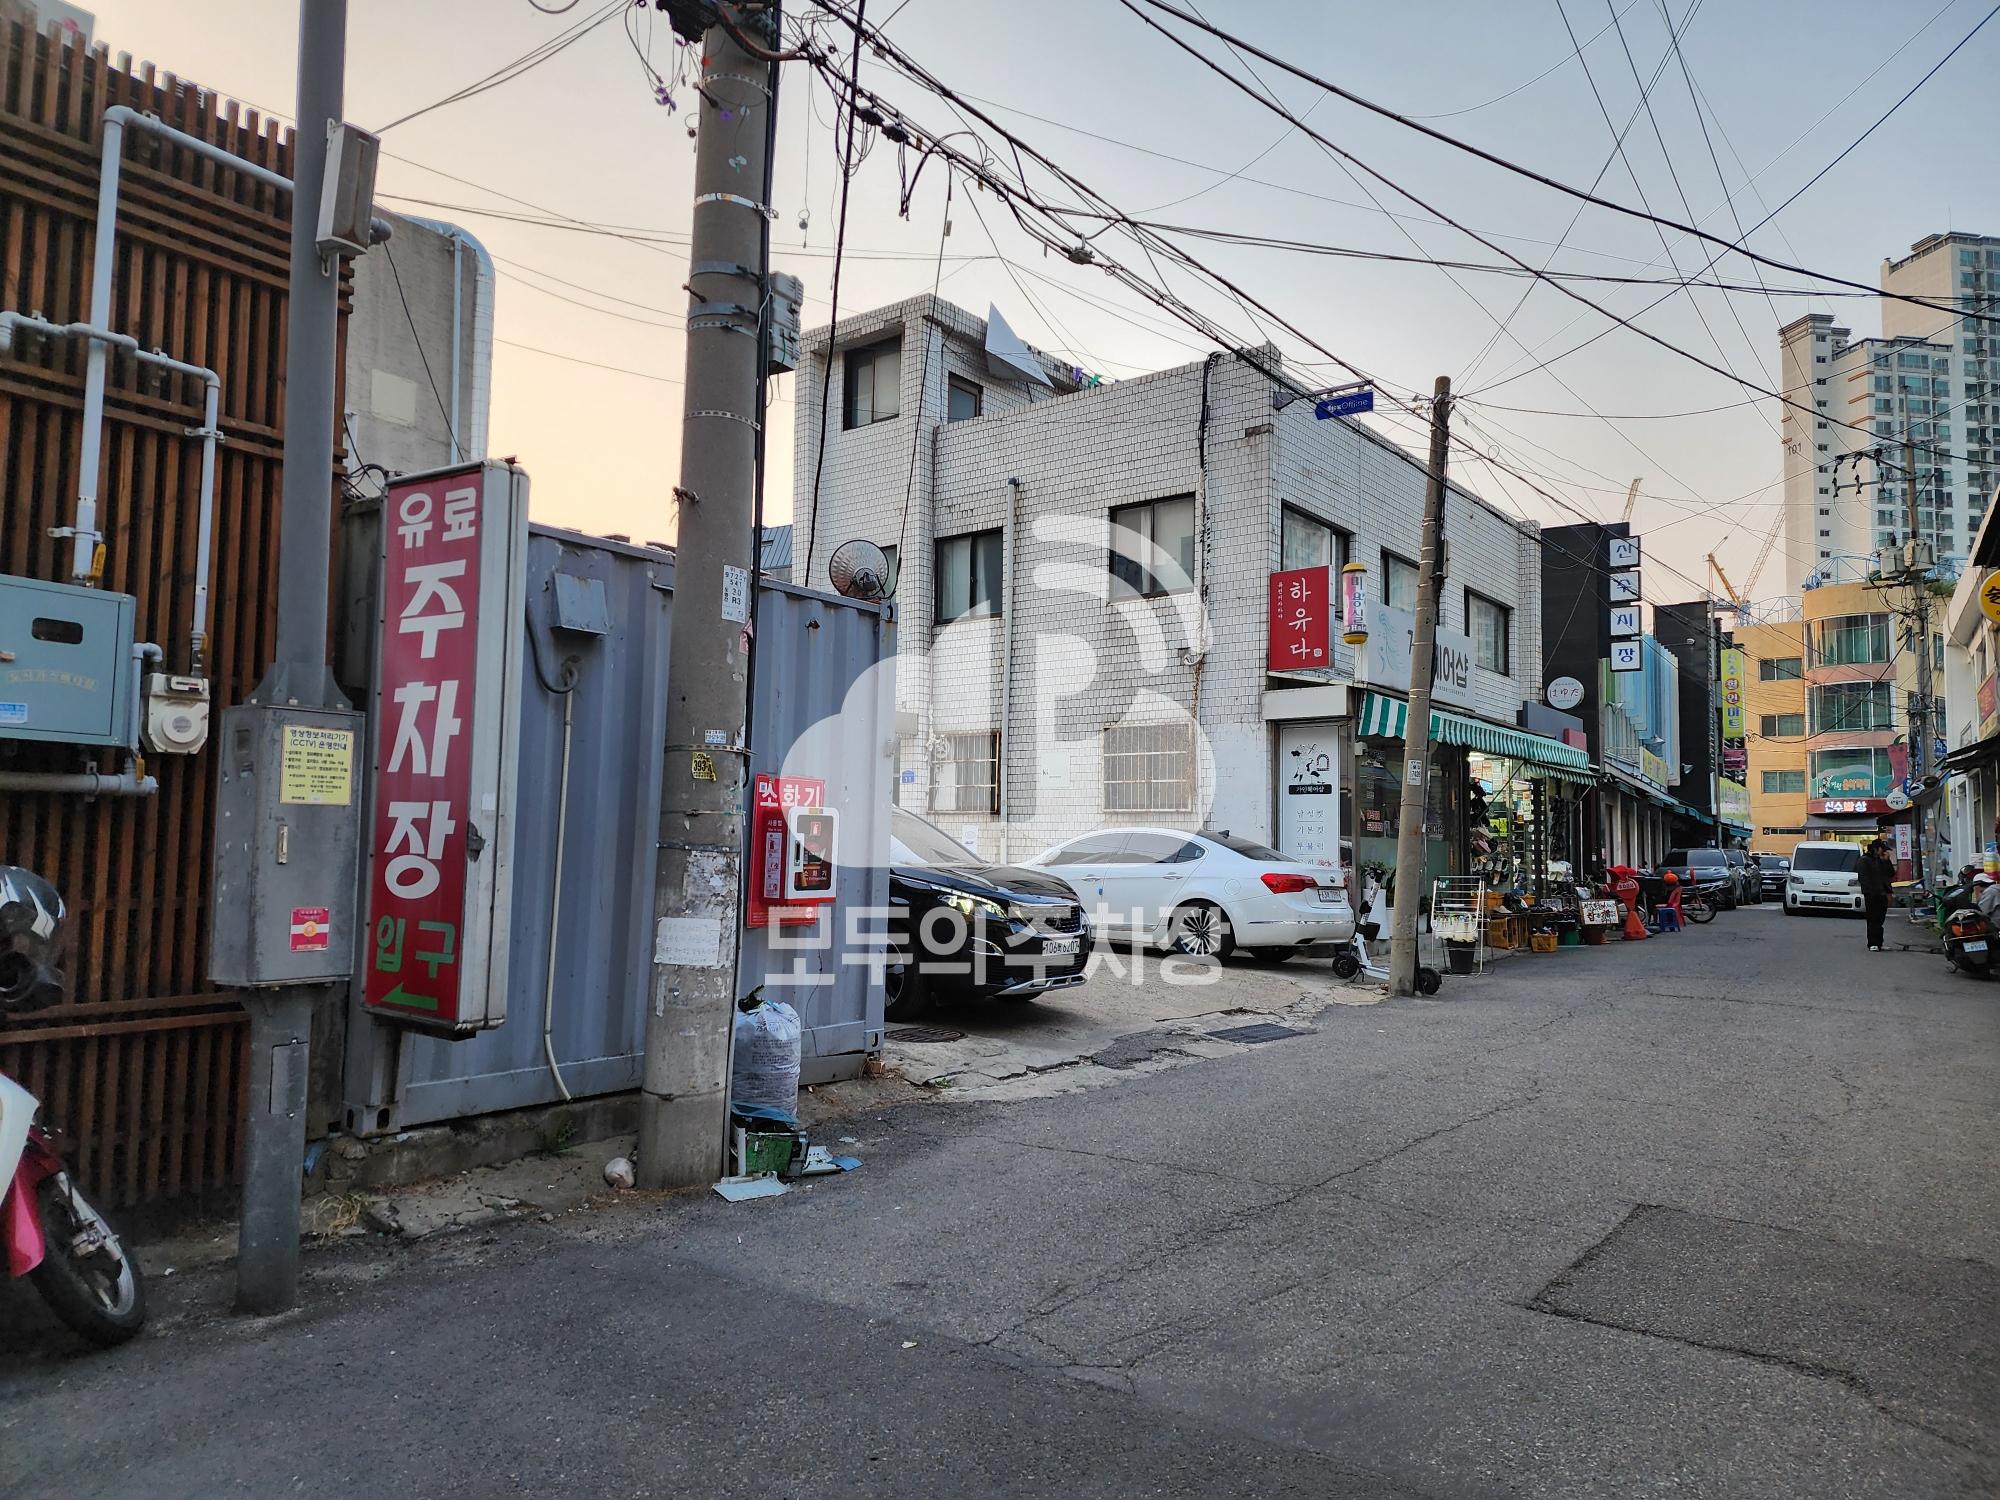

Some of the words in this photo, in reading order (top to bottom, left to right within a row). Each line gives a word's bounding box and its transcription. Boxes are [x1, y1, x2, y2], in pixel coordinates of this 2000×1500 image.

[397, 487, 477, 549] 유료
[1289, 577, 1312, 661] 하유다
[1351, 576, 1365, 624] 미용실
[1616, 544, 1636, 664] 신수시장
[290, 729, 348, 742] 영상정보처리기기
[290, 738, 316, 748] (CCTV)
[319, 741, 347, 751] 운영안내
[384, 559, 467, 899] 주차장
[759, 781, 820, 808] 소화기
[376, 914, 456, 978] 입구
